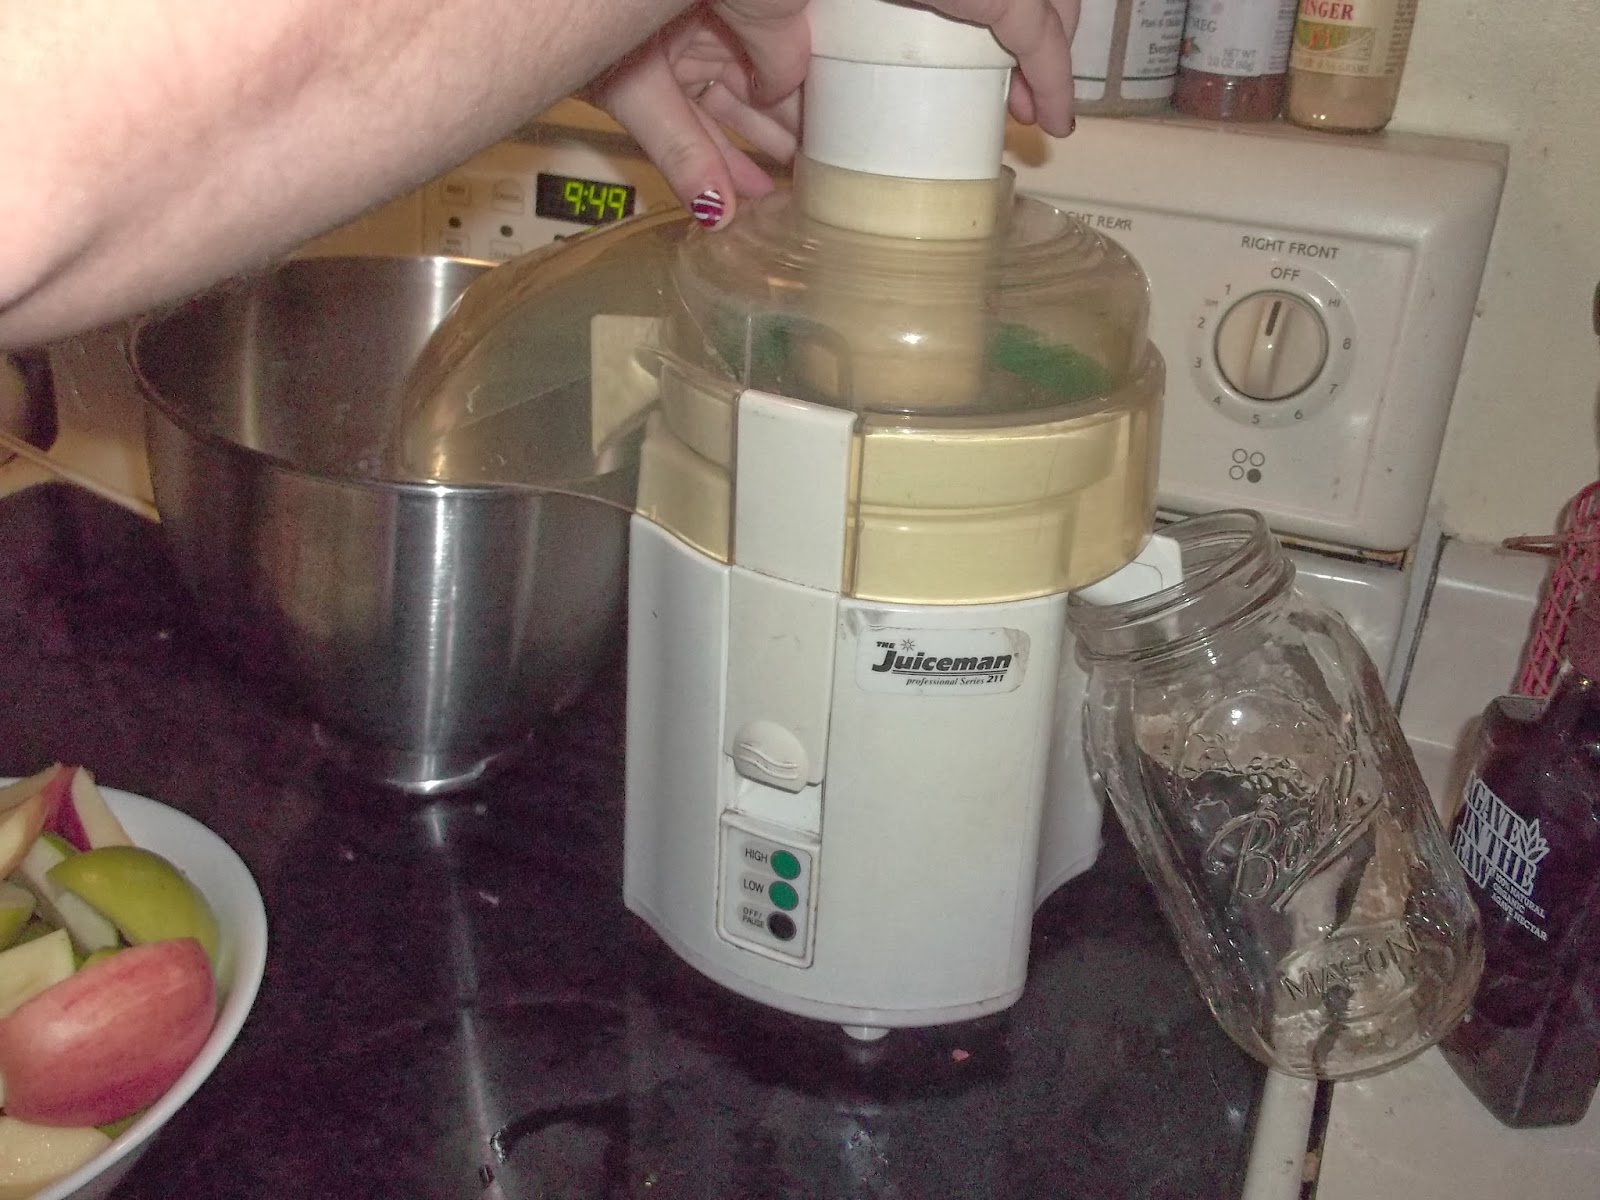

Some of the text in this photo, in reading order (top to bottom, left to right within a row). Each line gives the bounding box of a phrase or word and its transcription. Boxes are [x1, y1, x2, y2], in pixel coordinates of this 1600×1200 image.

[564, 181, 628, 219] 9:49
[1096, 215, 1133, 232] REAR
[1241, 235, 1339, 259] RIGHT FRONT
[1270, 267, 1301, 281] OFF
[1225, 284, 1231, 295] 1
[1197, 317, 1206, 329] 2
[1343, 337, 1352, 350] 8
[1194, 356, 1202, 369] 3
[1329, 383, 1338, 395] 7
[1213, 396, 1221, 406] 4
[1251, 413, 1260, 425] 5
[1294, 409, 1303, 420] 6
[876, 641, 896, 649] THE
[871, 650, 1013, 673] Juiceman
[906, 674, 1004, 686] professional Series 211
[745, 848, 768, 863] HIGH
[1486, 828, 1535, 893] THE
[743, 878, 764, 894] LOW
[1493, 882, 1526, 914] ORGANIC
[1510, 885, 1546, 919] NATURAL
[742, 916, 765, 929] PAUSE
[1491, 892, 1548, 941] AGAVE NECTAR
[1280, 928, 1419, 1000] MASON
